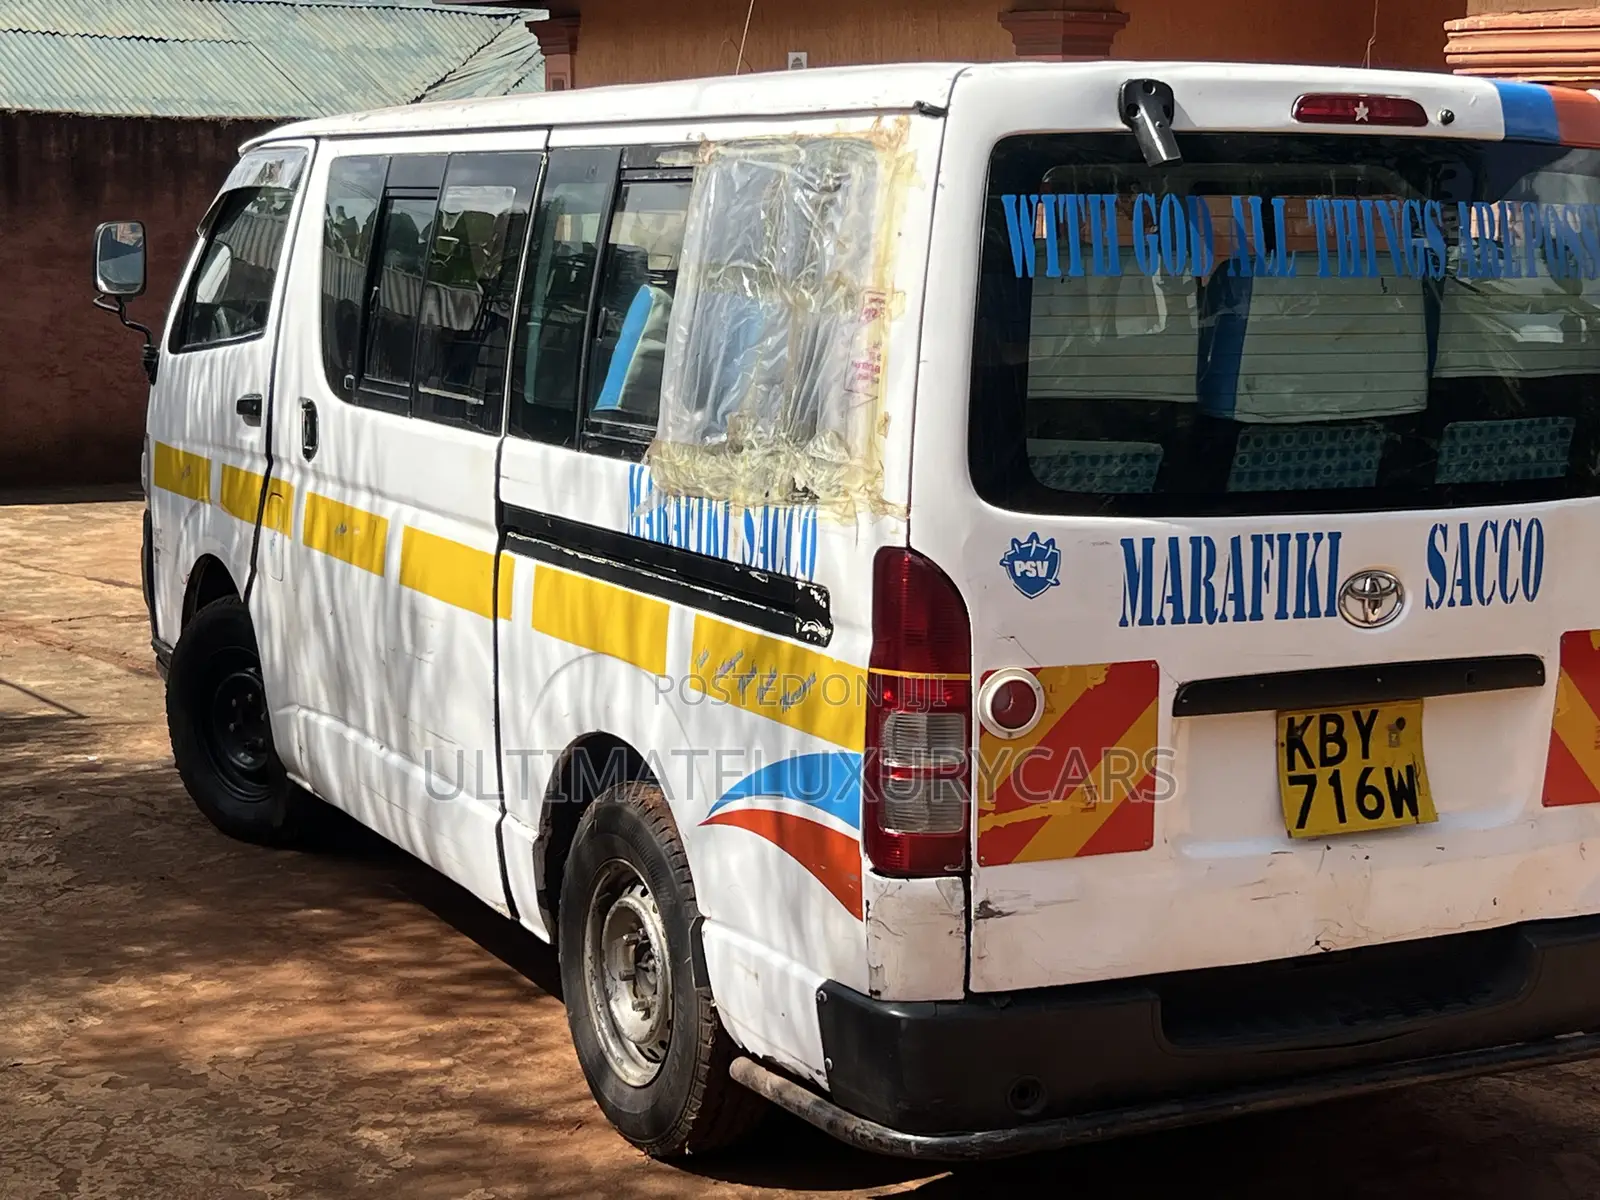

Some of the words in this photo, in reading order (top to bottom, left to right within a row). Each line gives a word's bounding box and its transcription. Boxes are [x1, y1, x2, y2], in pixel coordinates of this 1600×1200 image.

[1001, 193, 1121, 278] WITH
[1132, 192, 1214, 278] GOD
[1227, 195, 1296, 277] ALL
[1306, 198, 1446, 282] THINGS
[1456, 200, 1521, 280] ARE
[1520, 200, 1600, 281] POSS
[1013, 560, 1049, 578] PSV
[1118, 531, 1342, 628] MARAFIKI
[1424, 517, 1545, 611] SACCO
[1286, 708, 1379, 773] KBY
[1287, 763, 1419, 830] 716W
